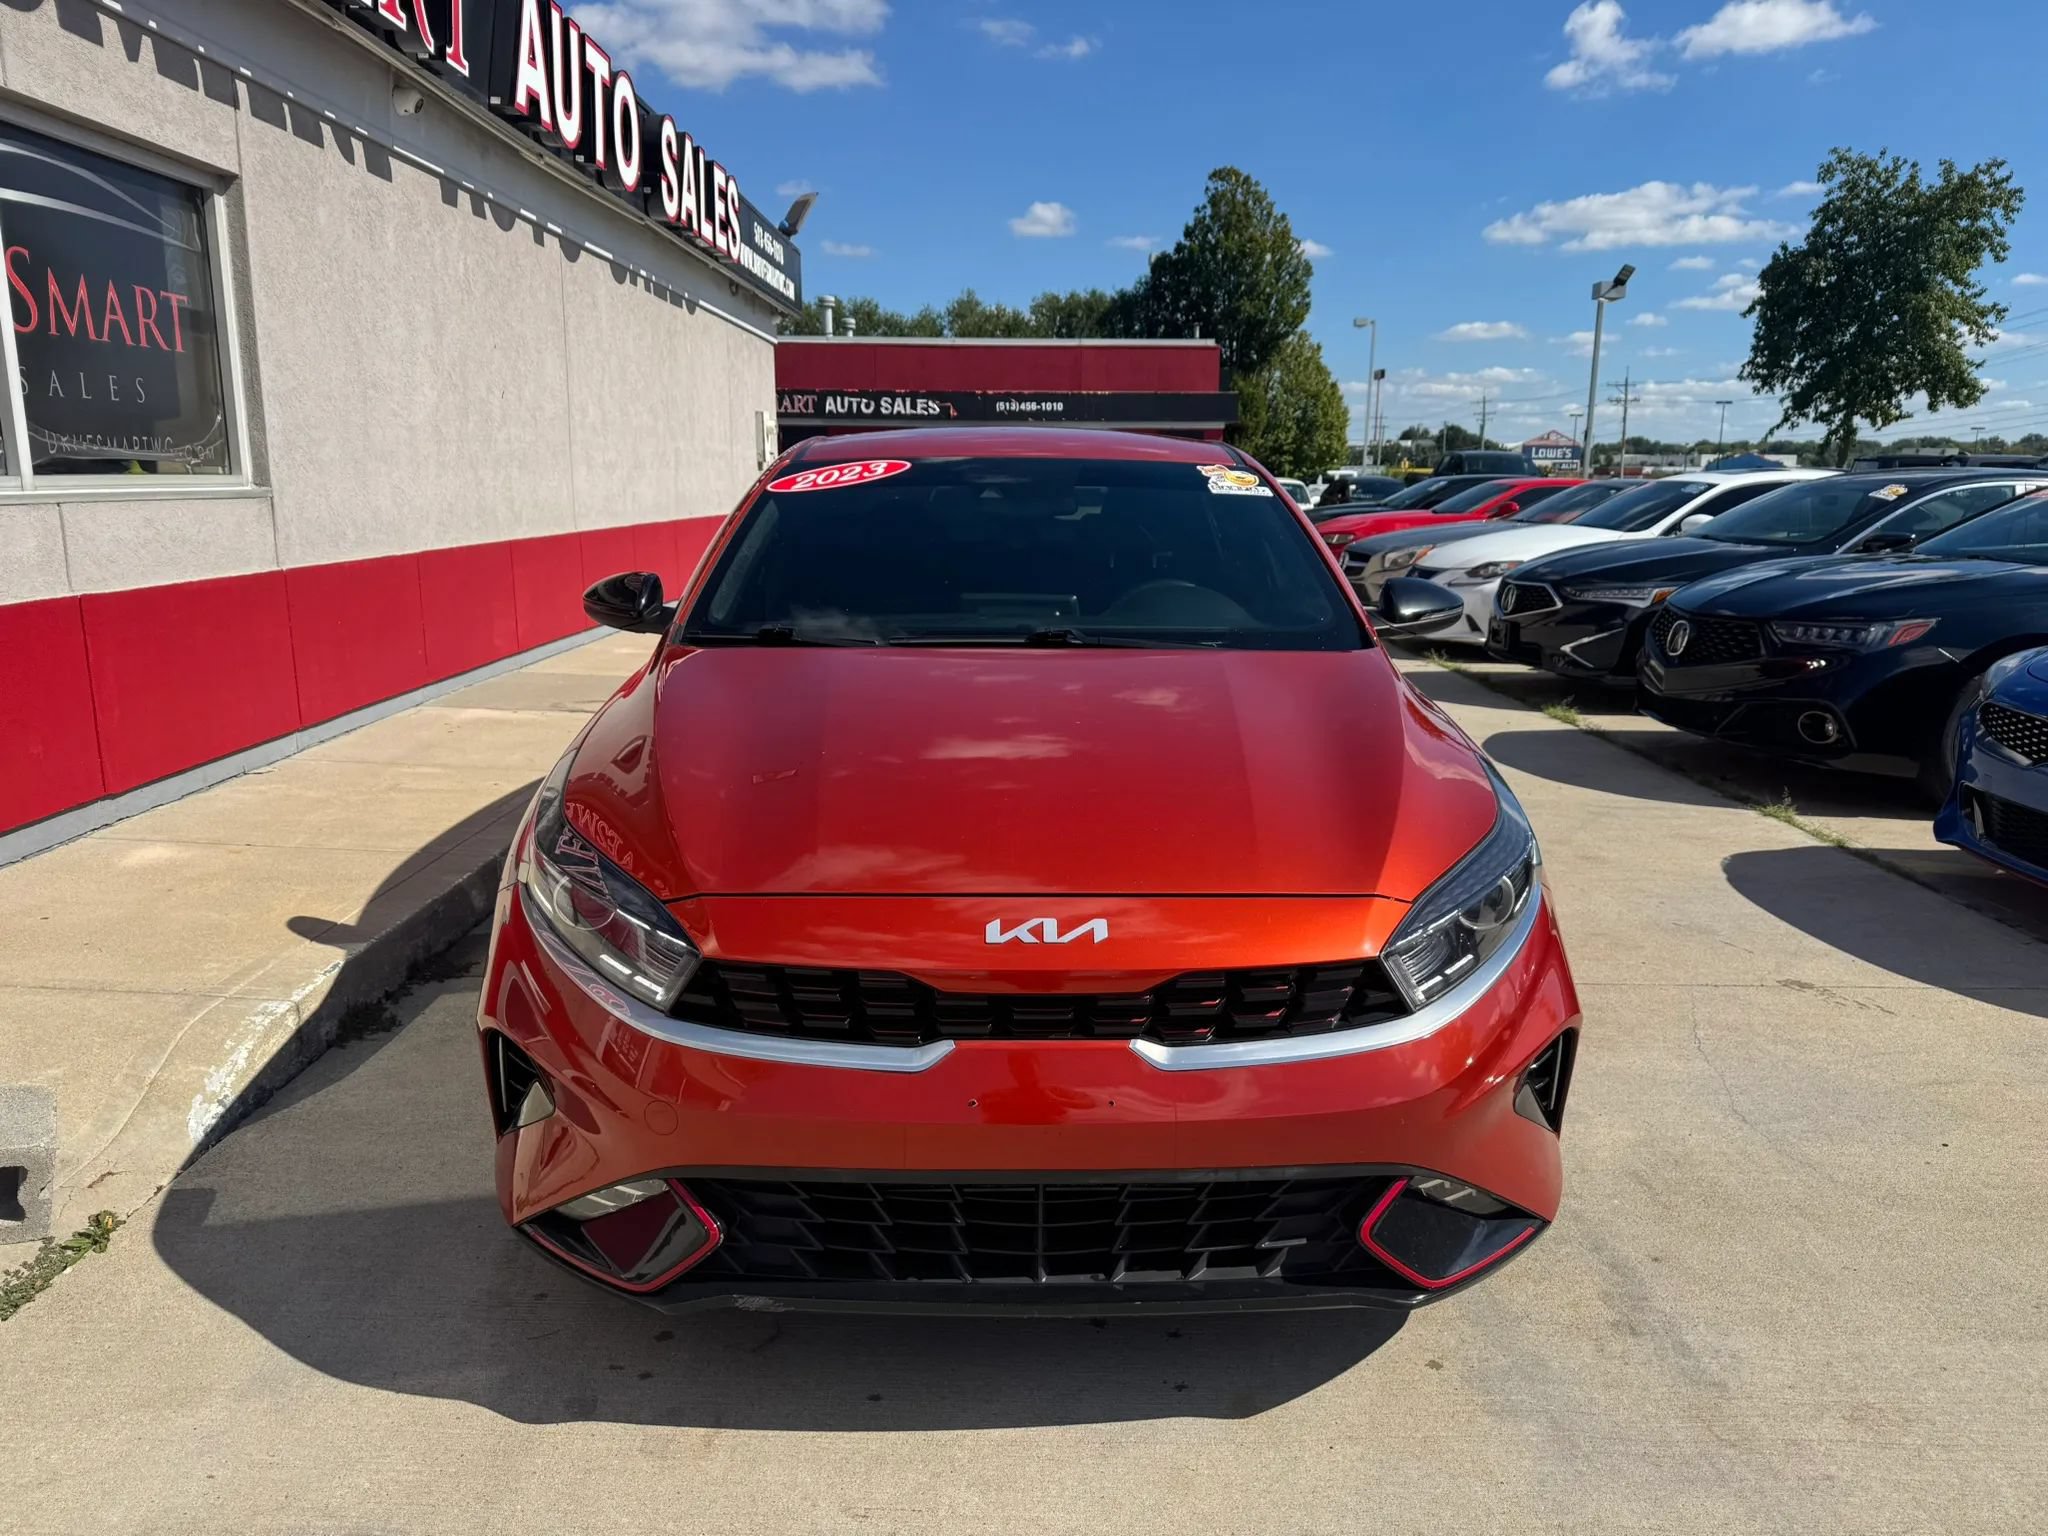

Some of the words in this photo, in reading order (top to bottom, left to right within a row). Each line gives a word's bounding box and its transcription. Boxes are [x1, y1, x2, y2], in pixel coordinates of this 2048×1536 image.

[514, 0, 641, 192] AUTO
[661, 114, 742, 264] SALES
[5, 246, 188, 352] SMART
[19, 366, 147, 403] SALES
[776, 394, 818, 414] ART
[825, 395, 875, 414] AUTO
[880, 396, 941, 416] SALES
[995, 401, 1064, 412] (513)456-1010
[1531, 446, 1573, 459] LOWE'S
[791, 462, 889, 490] 2023
[985, 917, 1109, 944] KIA
